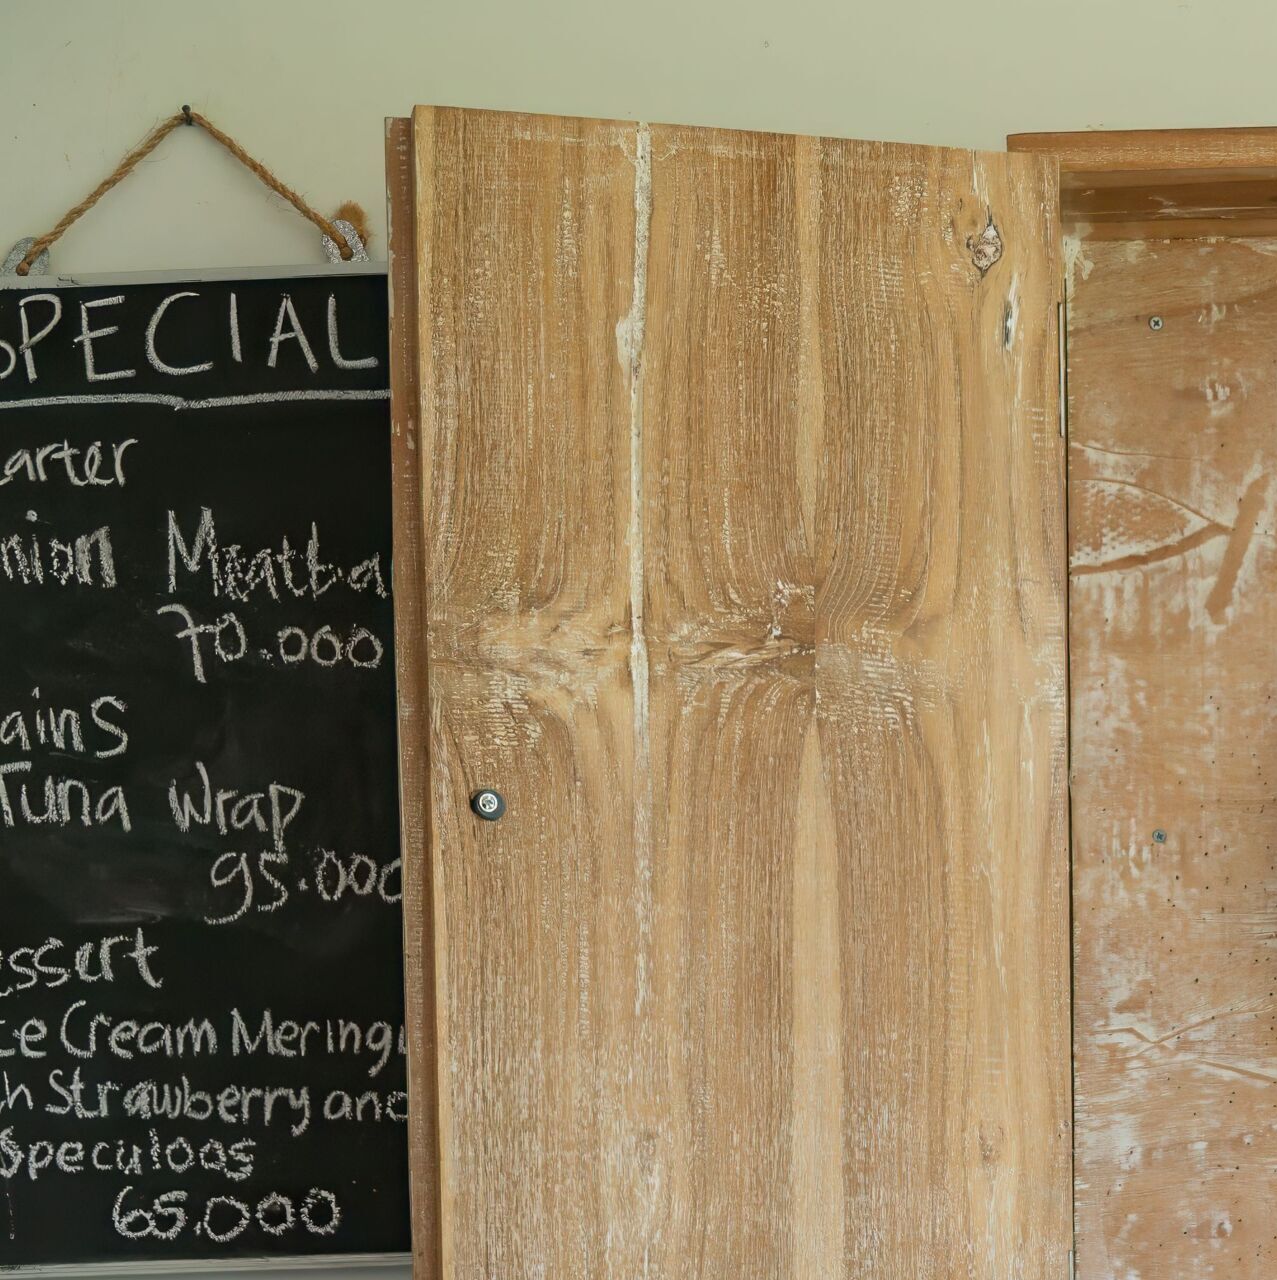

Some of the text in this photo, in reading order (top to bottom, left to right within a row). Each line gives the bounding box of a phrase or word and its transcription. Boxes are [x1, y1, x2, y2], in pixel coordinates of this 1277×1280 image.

[0, 438, 138, 488] arter
[157, 603, 384, 684] 70.000
[60, 1000, 218, 1058] Cream
[45, 1066, 311, 1137] Strawberry
[112, 1185, 341, 1243] 65.000
